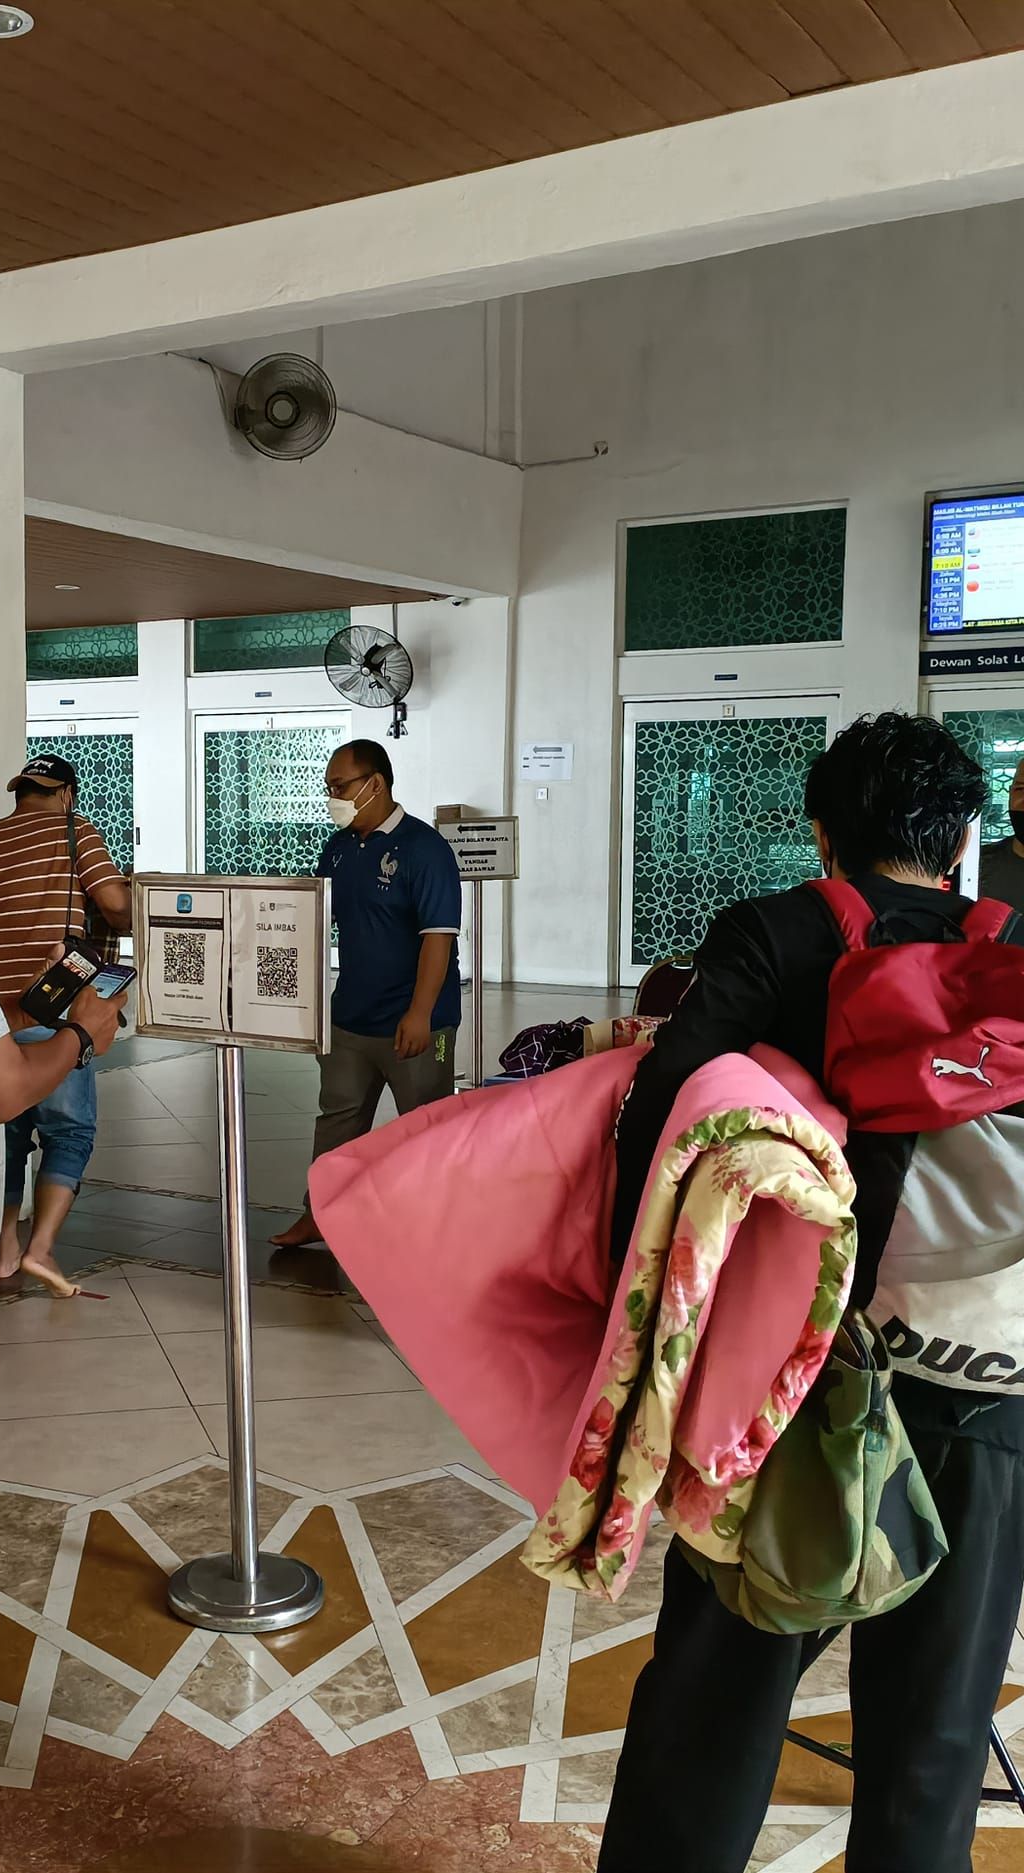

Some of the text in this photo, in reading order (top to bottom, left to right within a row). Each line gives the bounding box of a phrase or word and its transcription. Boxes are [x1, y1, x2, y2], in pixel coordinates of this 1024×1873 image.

[930, 658, 971, 668] Dewan
[977, 655, 1008, 665] Solat
[256, 922, 297, 933] SILA IMBAS
